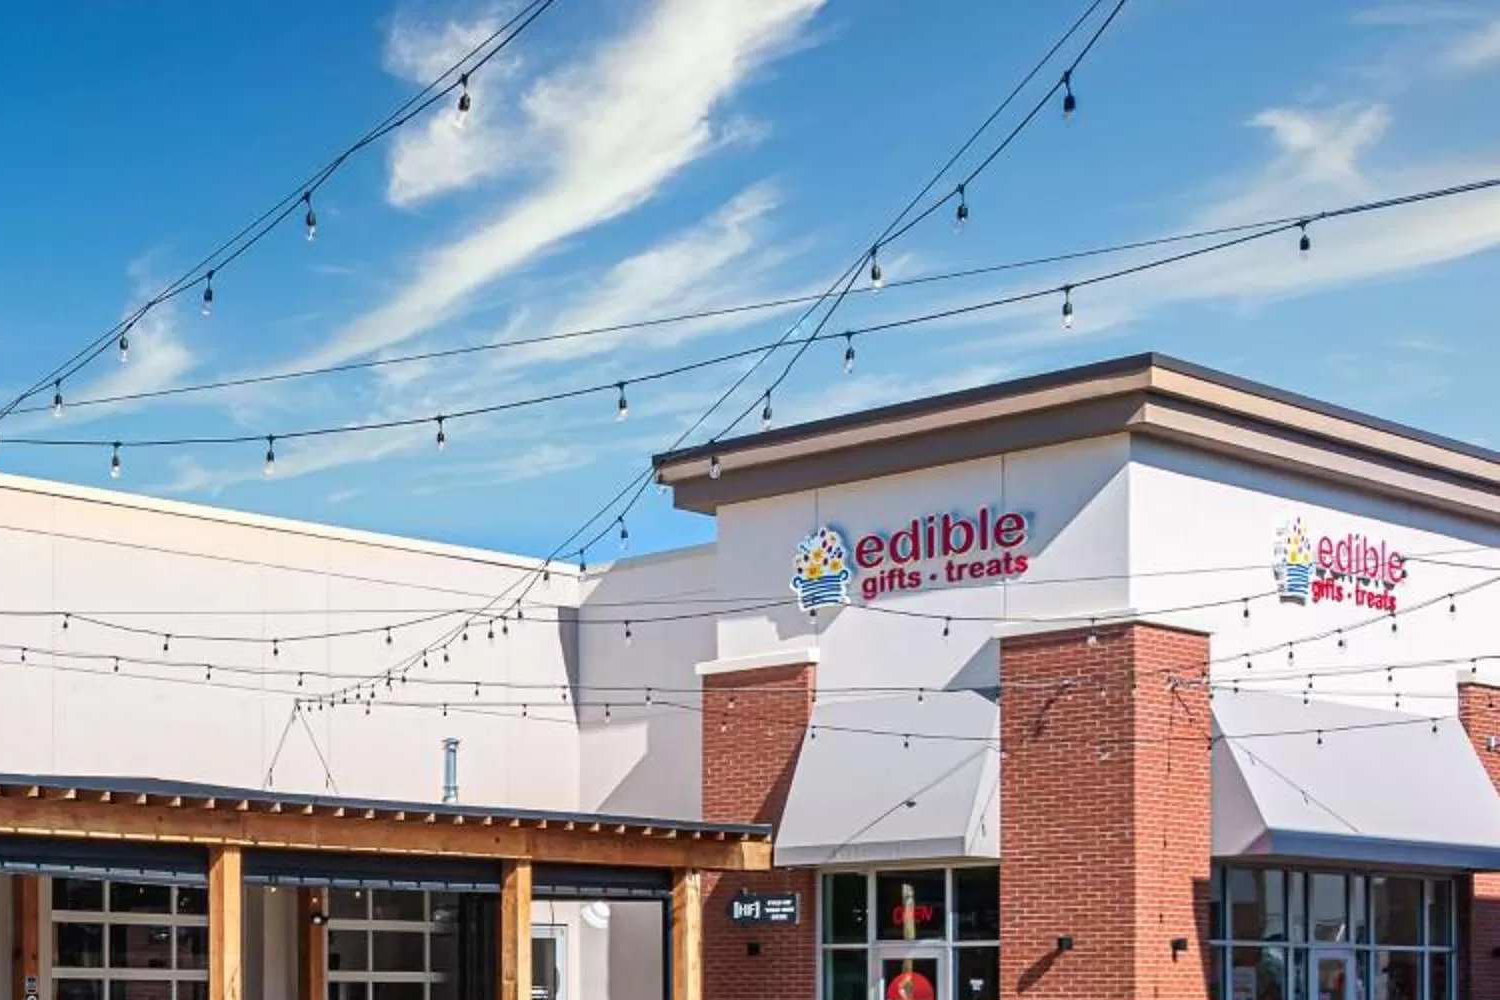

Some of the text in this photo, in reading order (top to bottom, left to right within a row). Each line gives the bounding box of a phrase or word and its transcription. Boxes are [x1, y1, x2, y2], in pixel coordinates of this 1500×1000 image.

[855, 507, 1026, 569] edible
[1318, 533, 1405, 583] edible
[862, 551, 1029, 600] gifts treats
[1312, 577, 1396, 611] gifts treats
[892, 904, 933, 925] OEN
